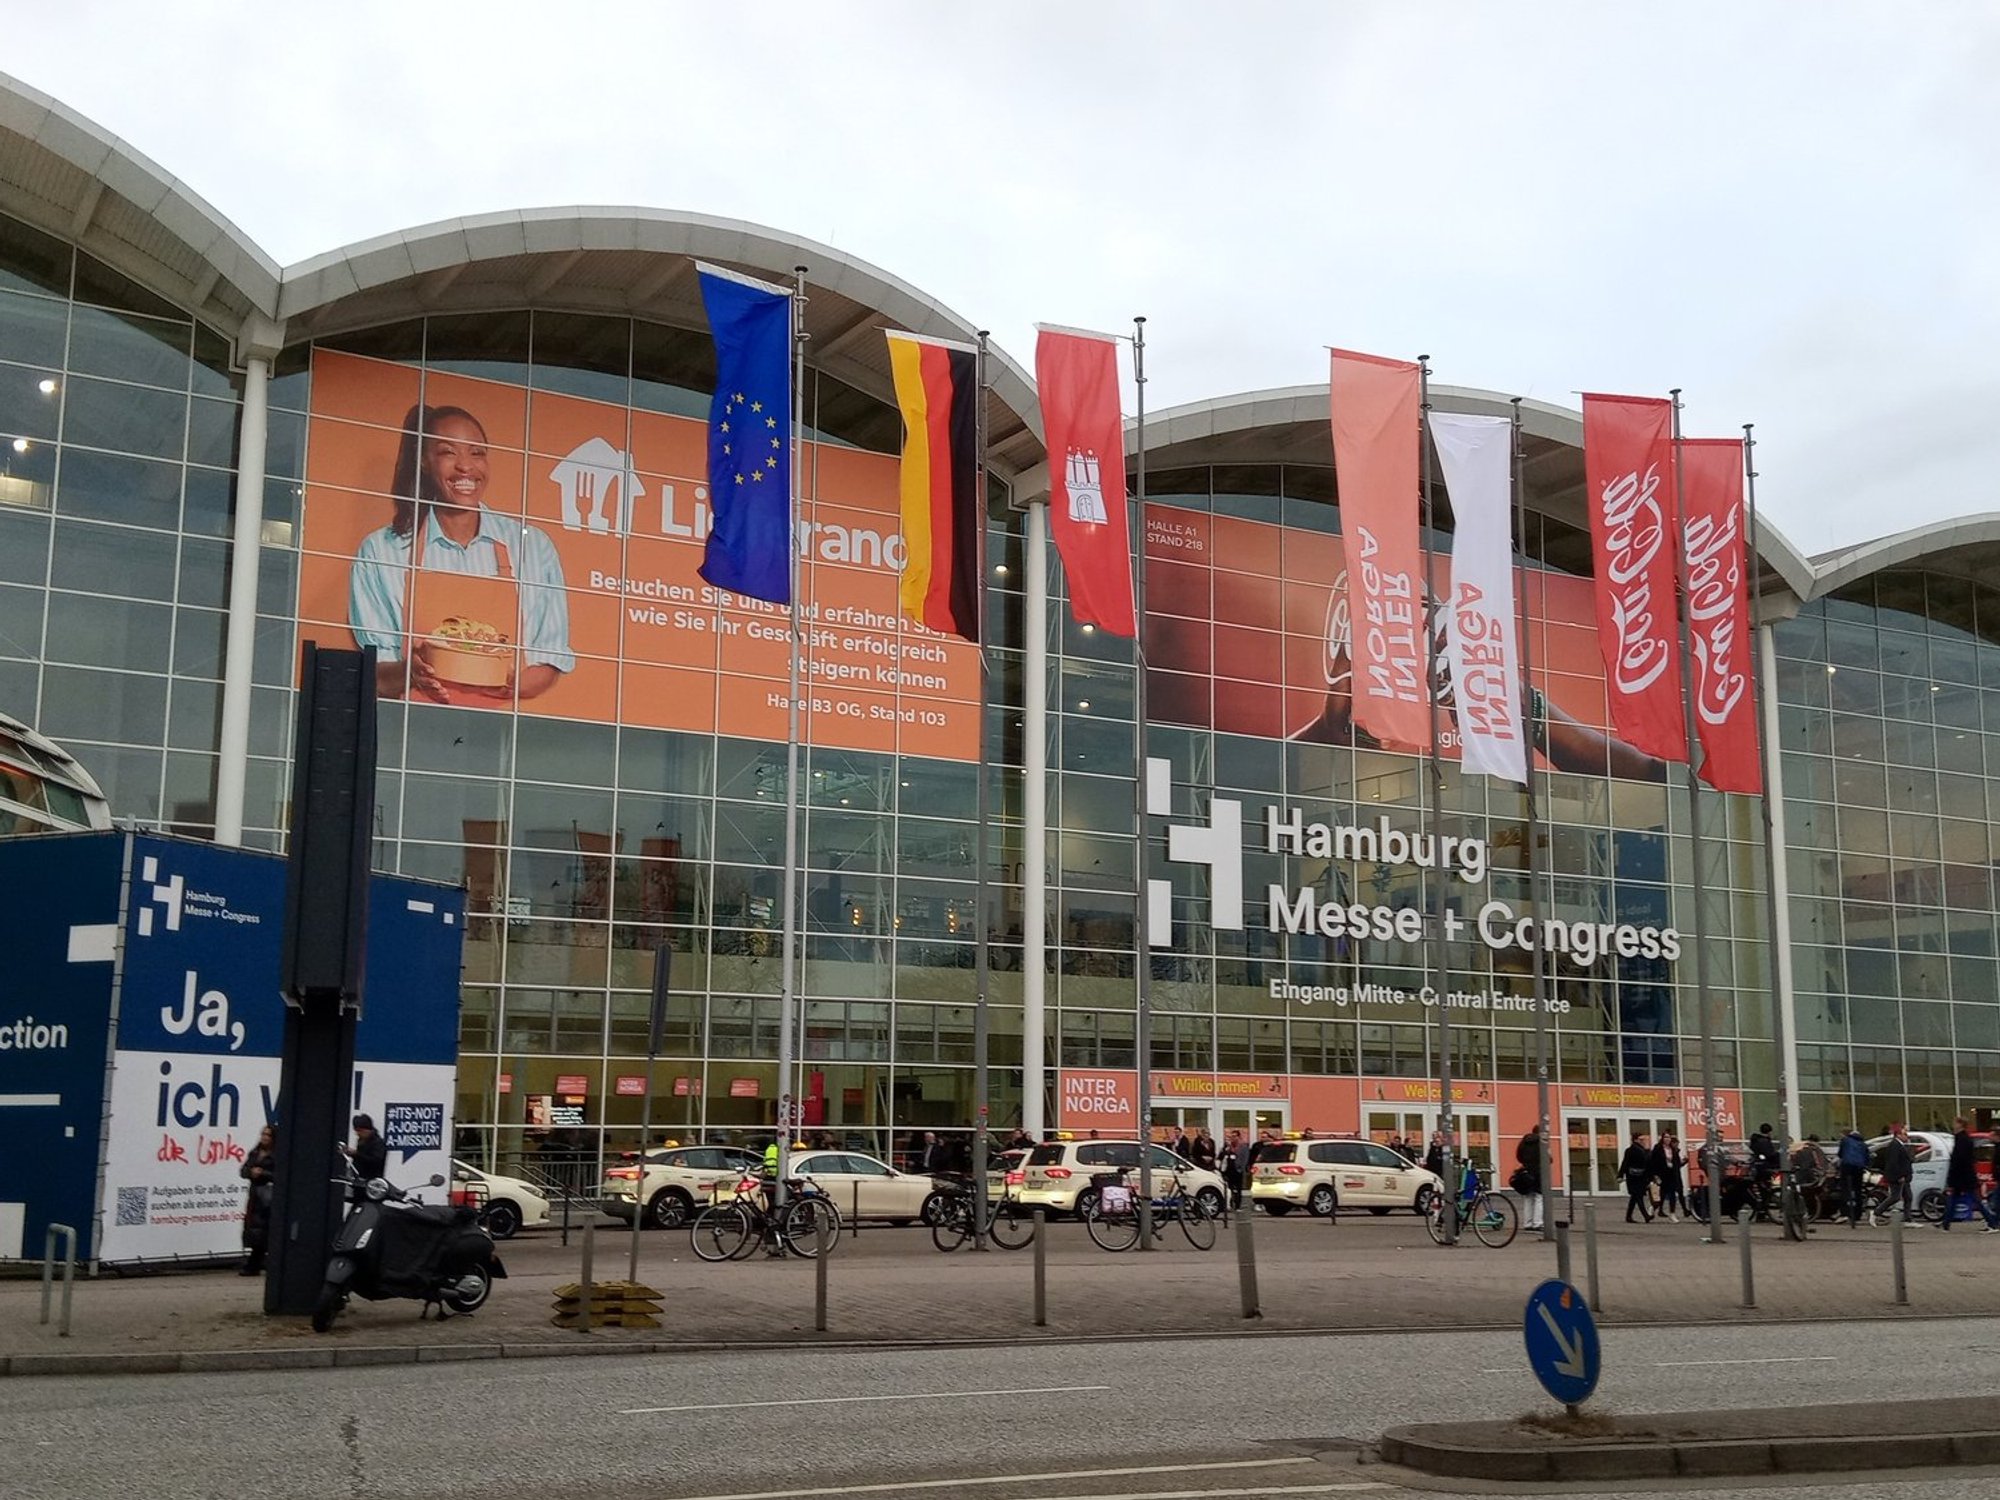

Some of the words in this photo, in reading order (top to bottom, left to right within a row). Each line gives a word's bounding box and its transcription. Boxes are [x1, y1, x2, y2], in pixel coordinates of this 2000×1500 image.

[1147, 520, 1182, 535] HALLE
[1185, 526, 1197, 537] A1
[1147, 532, 1183, 547] STAND
[1185, 539, 1203, 551] 218
[590, 570, 695, 602] Besuchen
[700, 586, 732, 607] Sie
[825, 607, 909, 632] erfahren
[628, 607, 668, 626] wie
[674, 611, 706, 632] Sie
[712, 616, 741, 636] Ihr
[842, 638, 947, 663] erfolgreich
[876, 665, 947, 690] können
[767, 693, 807, 711] Hae
[813, 699, 832, 714] B3
[836, 702, 865, 720] OG,
[870, 705, 915, 723] Stand
[920, 711, 946, 726] 103
[1268, 805, 1486, 883] Hamburg
[185, 889, 226, 907] Hamburg
[184, 904, 213, 918] Messe
[221, 909, 260, 924] Congress
[1269, 884, 1423, 943] Messe
[1478, 901, 1681, 967] Congress
[1269, 978, 1349, 1006] Eingang
[1353, 983, 1405, 1005] Mitte
[161, 970, 245, 1051] Ja,
[0, 1015, 68, 1050] ction
[157, 1060, 240, 1128] ich
[1066, 1077, 1116, 1095] INTER
[1172, 1077, 1261, 1094] Willkommen!
[1066, 1096, 1131, 1114] NORGA
[1586, 1088, 1659, 1105] Willkommen!
[387, 1106, 441, 1120] #ITS-NOT-
[1687, 1110, 1737, 1127] NOGA
[386, 1134, 440, 1147] A-MISSION
[152, 1185, 194, 1198] Aufgaben
[194, 1184, 207, 1195] für
[151, 1200, 182, 1211] suchen
[183, 1199, 195, 1210] als
[196, 1200, 220, 1210] einen
